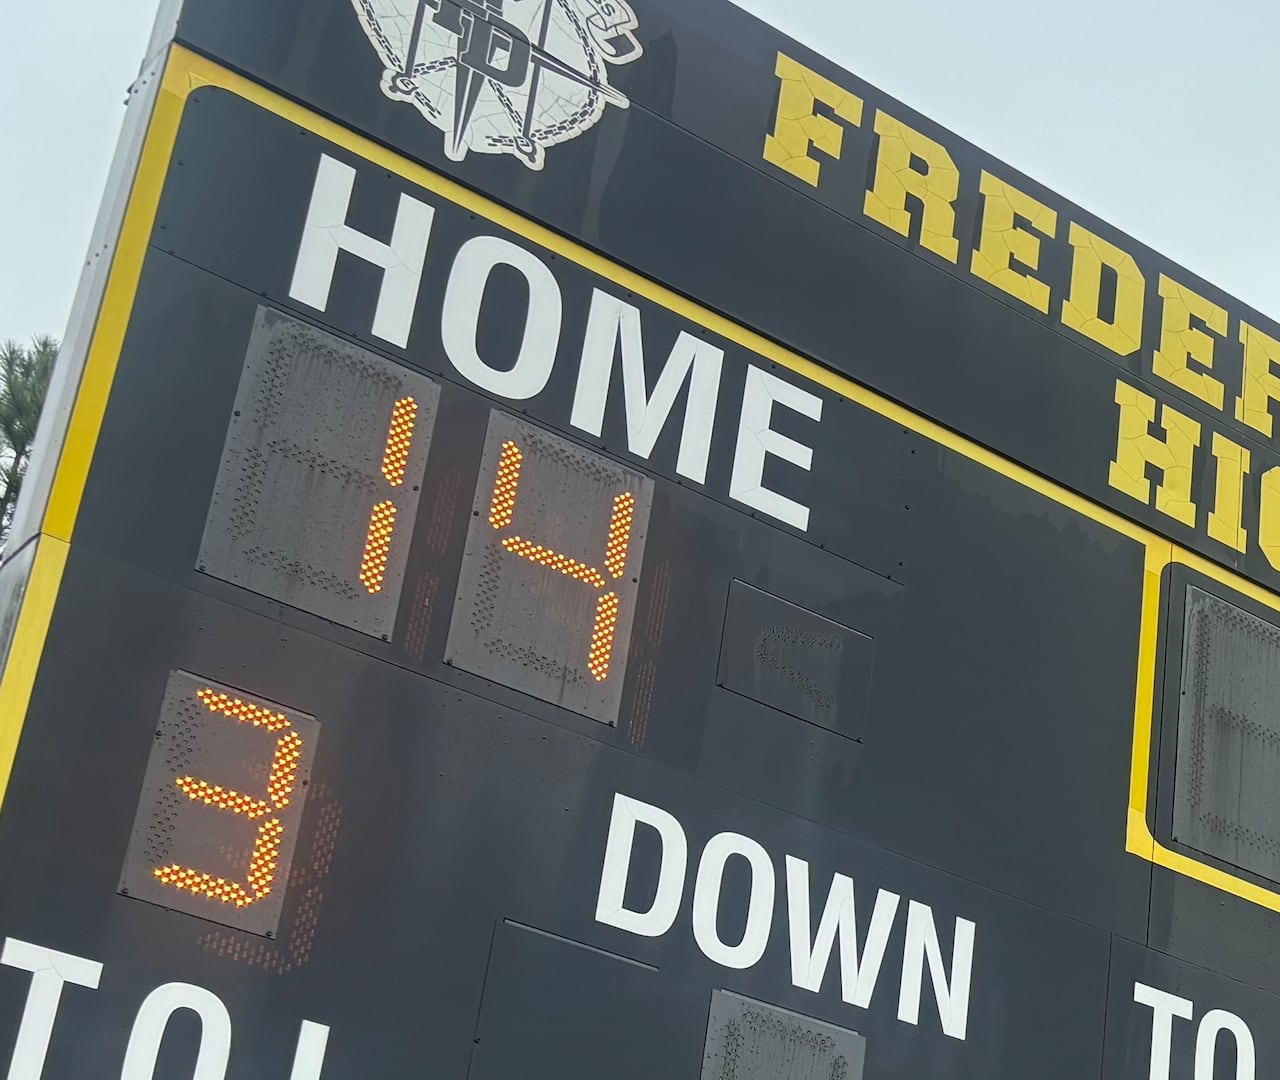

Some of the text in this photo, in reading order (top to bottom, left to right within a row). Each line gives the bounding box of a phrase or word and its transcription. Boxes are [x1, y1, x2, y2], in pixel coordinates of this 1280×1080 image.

[288, 153, 823, 532] HOME
[359, 397, 636, 683] 14
[153, 688, 302, 908] 3
[595, 792, 976, 1040] DOWN
